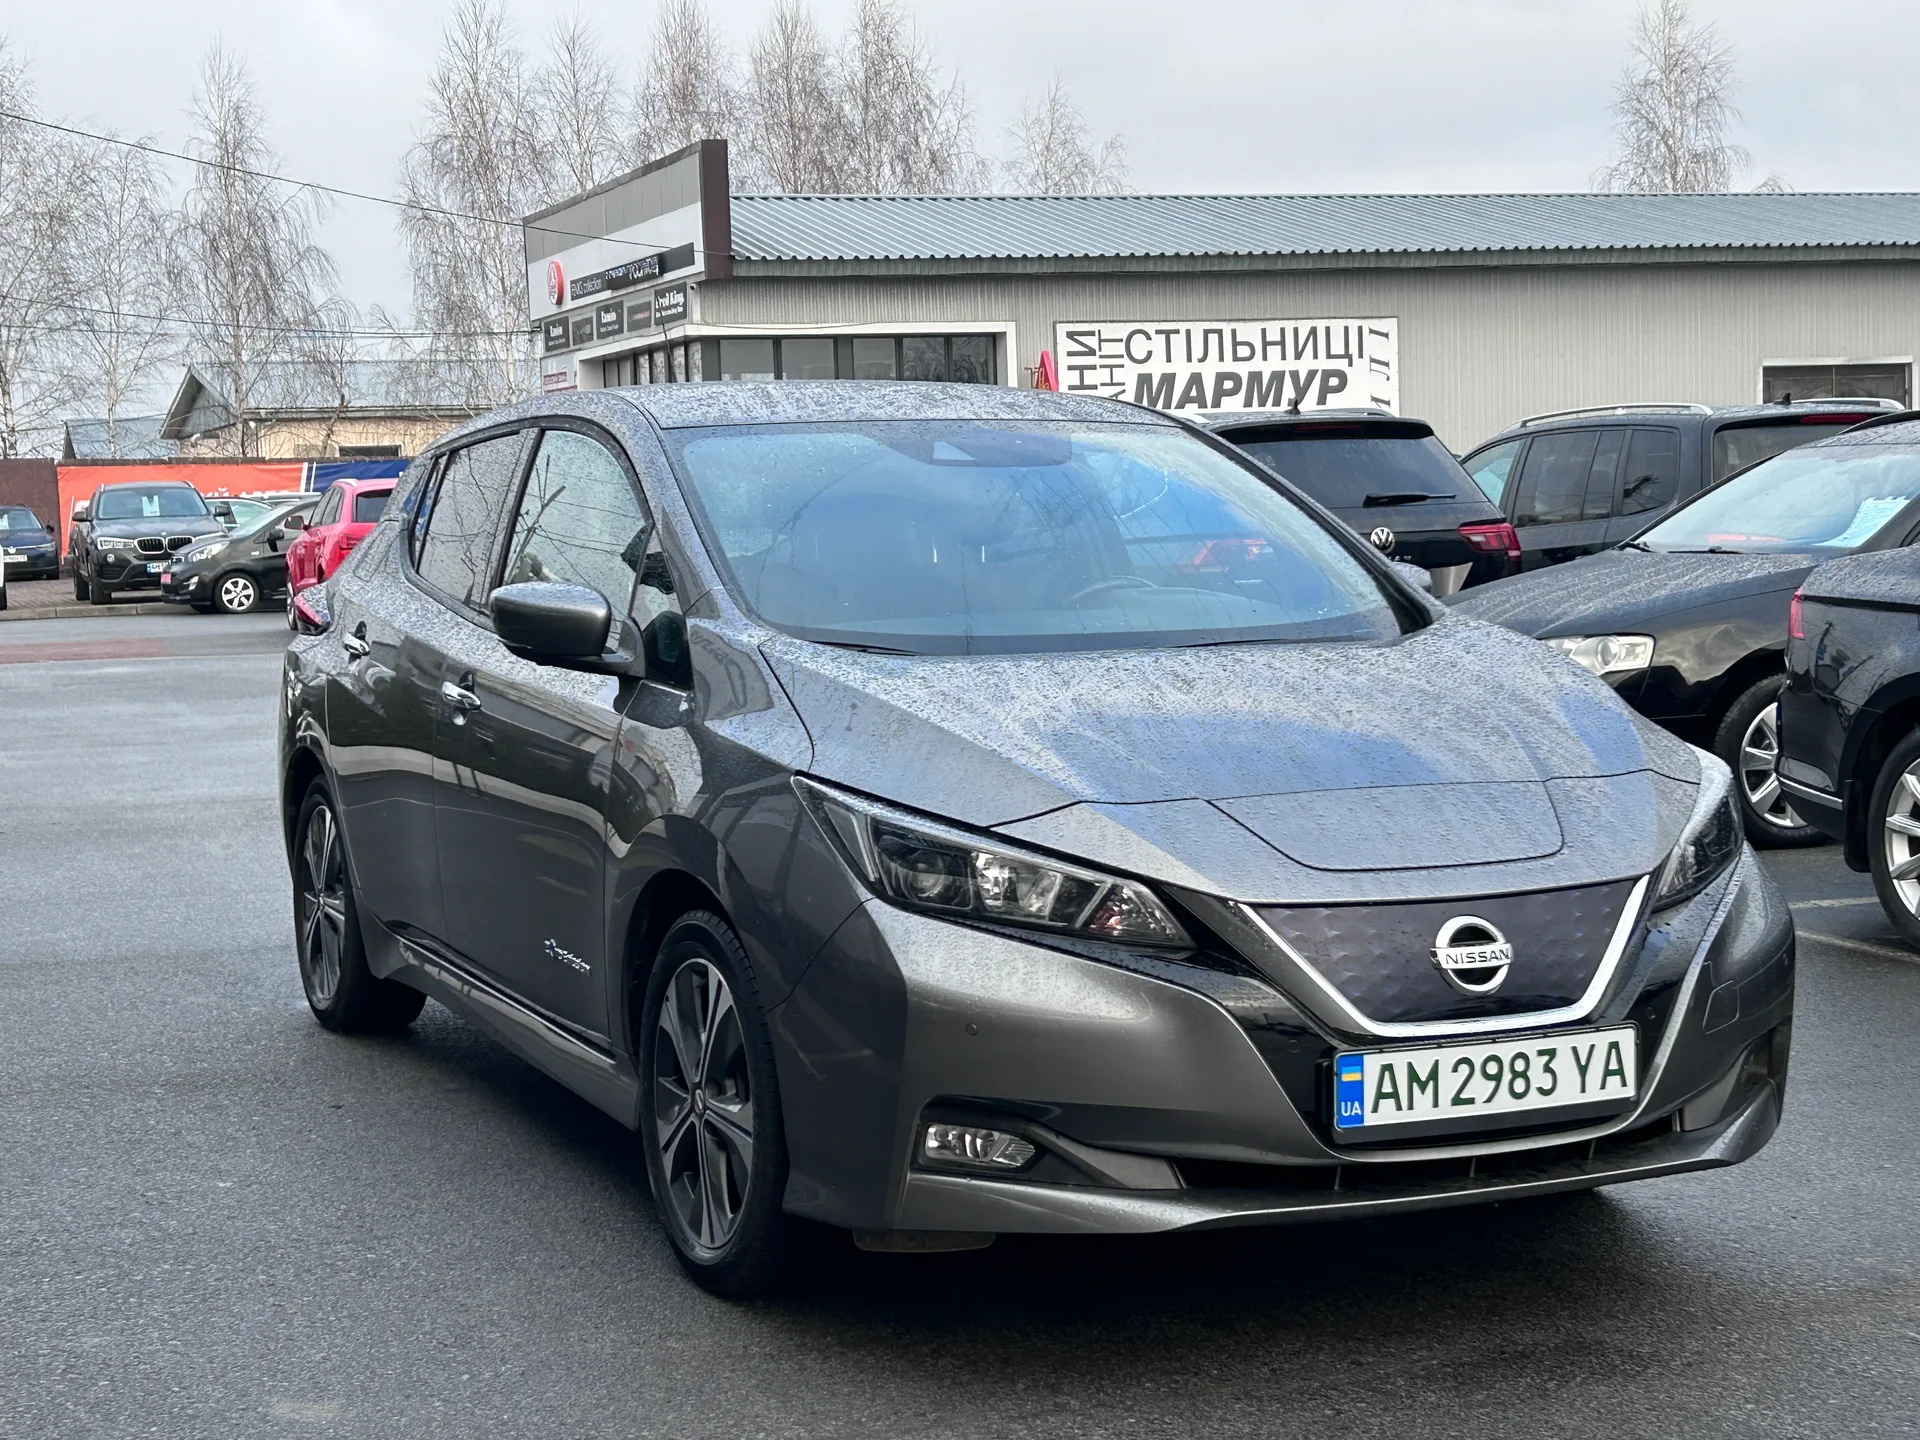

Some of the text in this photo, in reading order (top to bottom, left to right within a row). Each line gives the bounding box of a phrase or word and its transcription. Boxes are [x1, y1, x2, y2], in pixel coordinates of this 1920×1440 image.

[1124, 325, 1364, 367] СТІЛЬНИЦІ
[1133, 368, 1349, 410] МАРМУР
[1445, 948, 1510, 965] NISSAN
[1371, 1040, 1628, 1114] AM 2983 YA
[1341, 1101, 1362, 1116] UA
